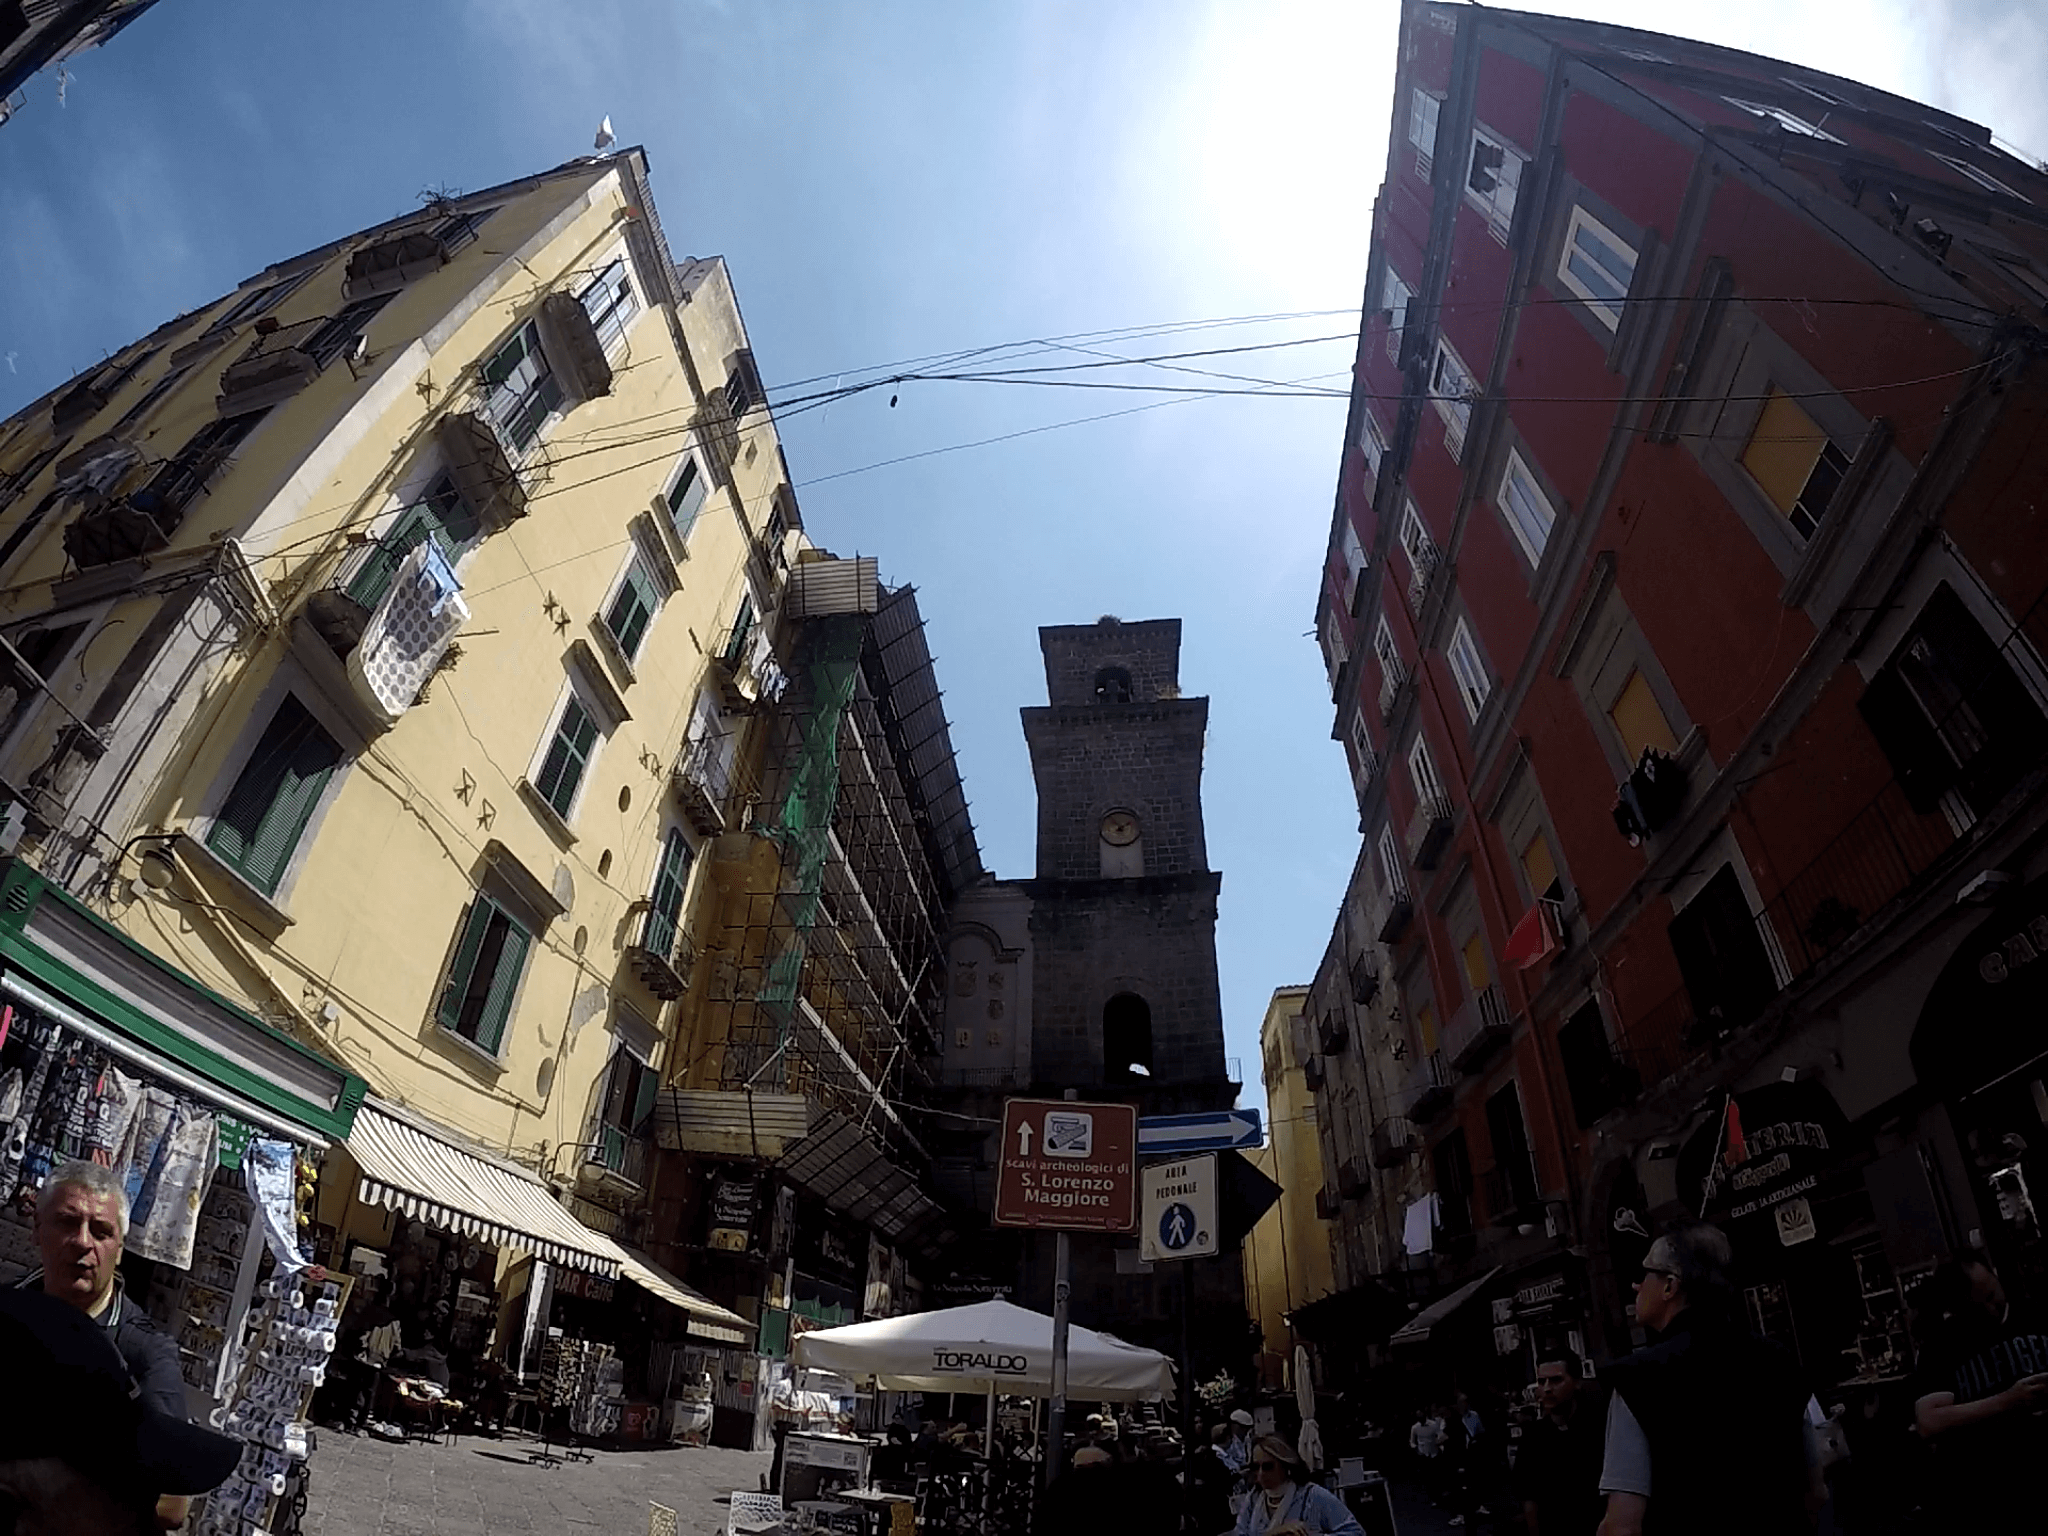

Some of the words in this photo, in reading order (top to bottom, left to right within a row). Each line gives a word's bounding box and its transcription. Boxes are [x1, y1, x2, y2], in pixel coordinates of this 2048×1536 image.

[1006, 1159, 1036, 1170] scavi
[1040, 1160, 1113, 1175] archeologici
[1117, 1163, 1129, 1174] di
[1021, 1173, 1036, 1187] S.
[1042, 1174, 1114, 1191] Lorenzo
[1156, 1182, 1198, 1200] PEDONALE
[1024, 1188, 1110, 1208] Maggiore
[933, 1353, 1027, 1370] TORALDO
